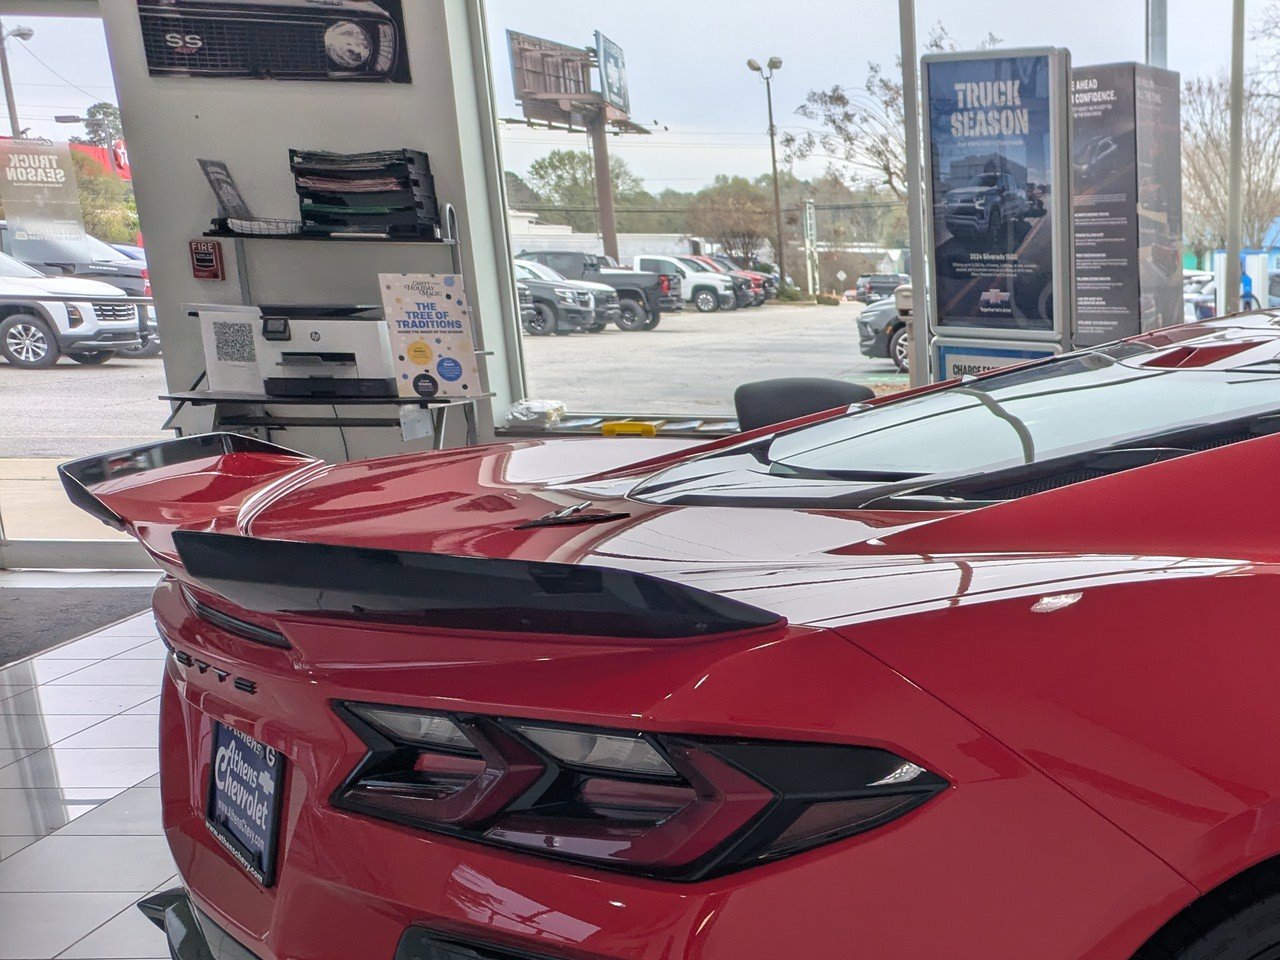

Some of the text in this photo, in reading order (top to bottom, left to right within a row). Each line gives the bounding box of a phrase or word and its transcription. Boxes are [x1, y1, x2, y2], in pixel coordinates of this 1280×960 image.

[165, 33, 203, 48] SS
[1076, 79, 1098, 91] AHEAD
[954, 80, 1021, 108] TRUCK
[1075, 90, 1117, 103] CONFIDENCE.
[950, 108, 1029, 137] SEASON
[191, 242, 214, 252] FIRE
[415, 302, 437, 311] THE
[405, 311, 449, 320] TREE OF
[396, 320, 462, 329] TRADITIONS
[171, 647, 257, 695] ETTE
[227, 740, 259, 788] Athens
[215, 746, 268, 830] Chevrolet
[206, 820, 263, 884] www.athenschevy.com
